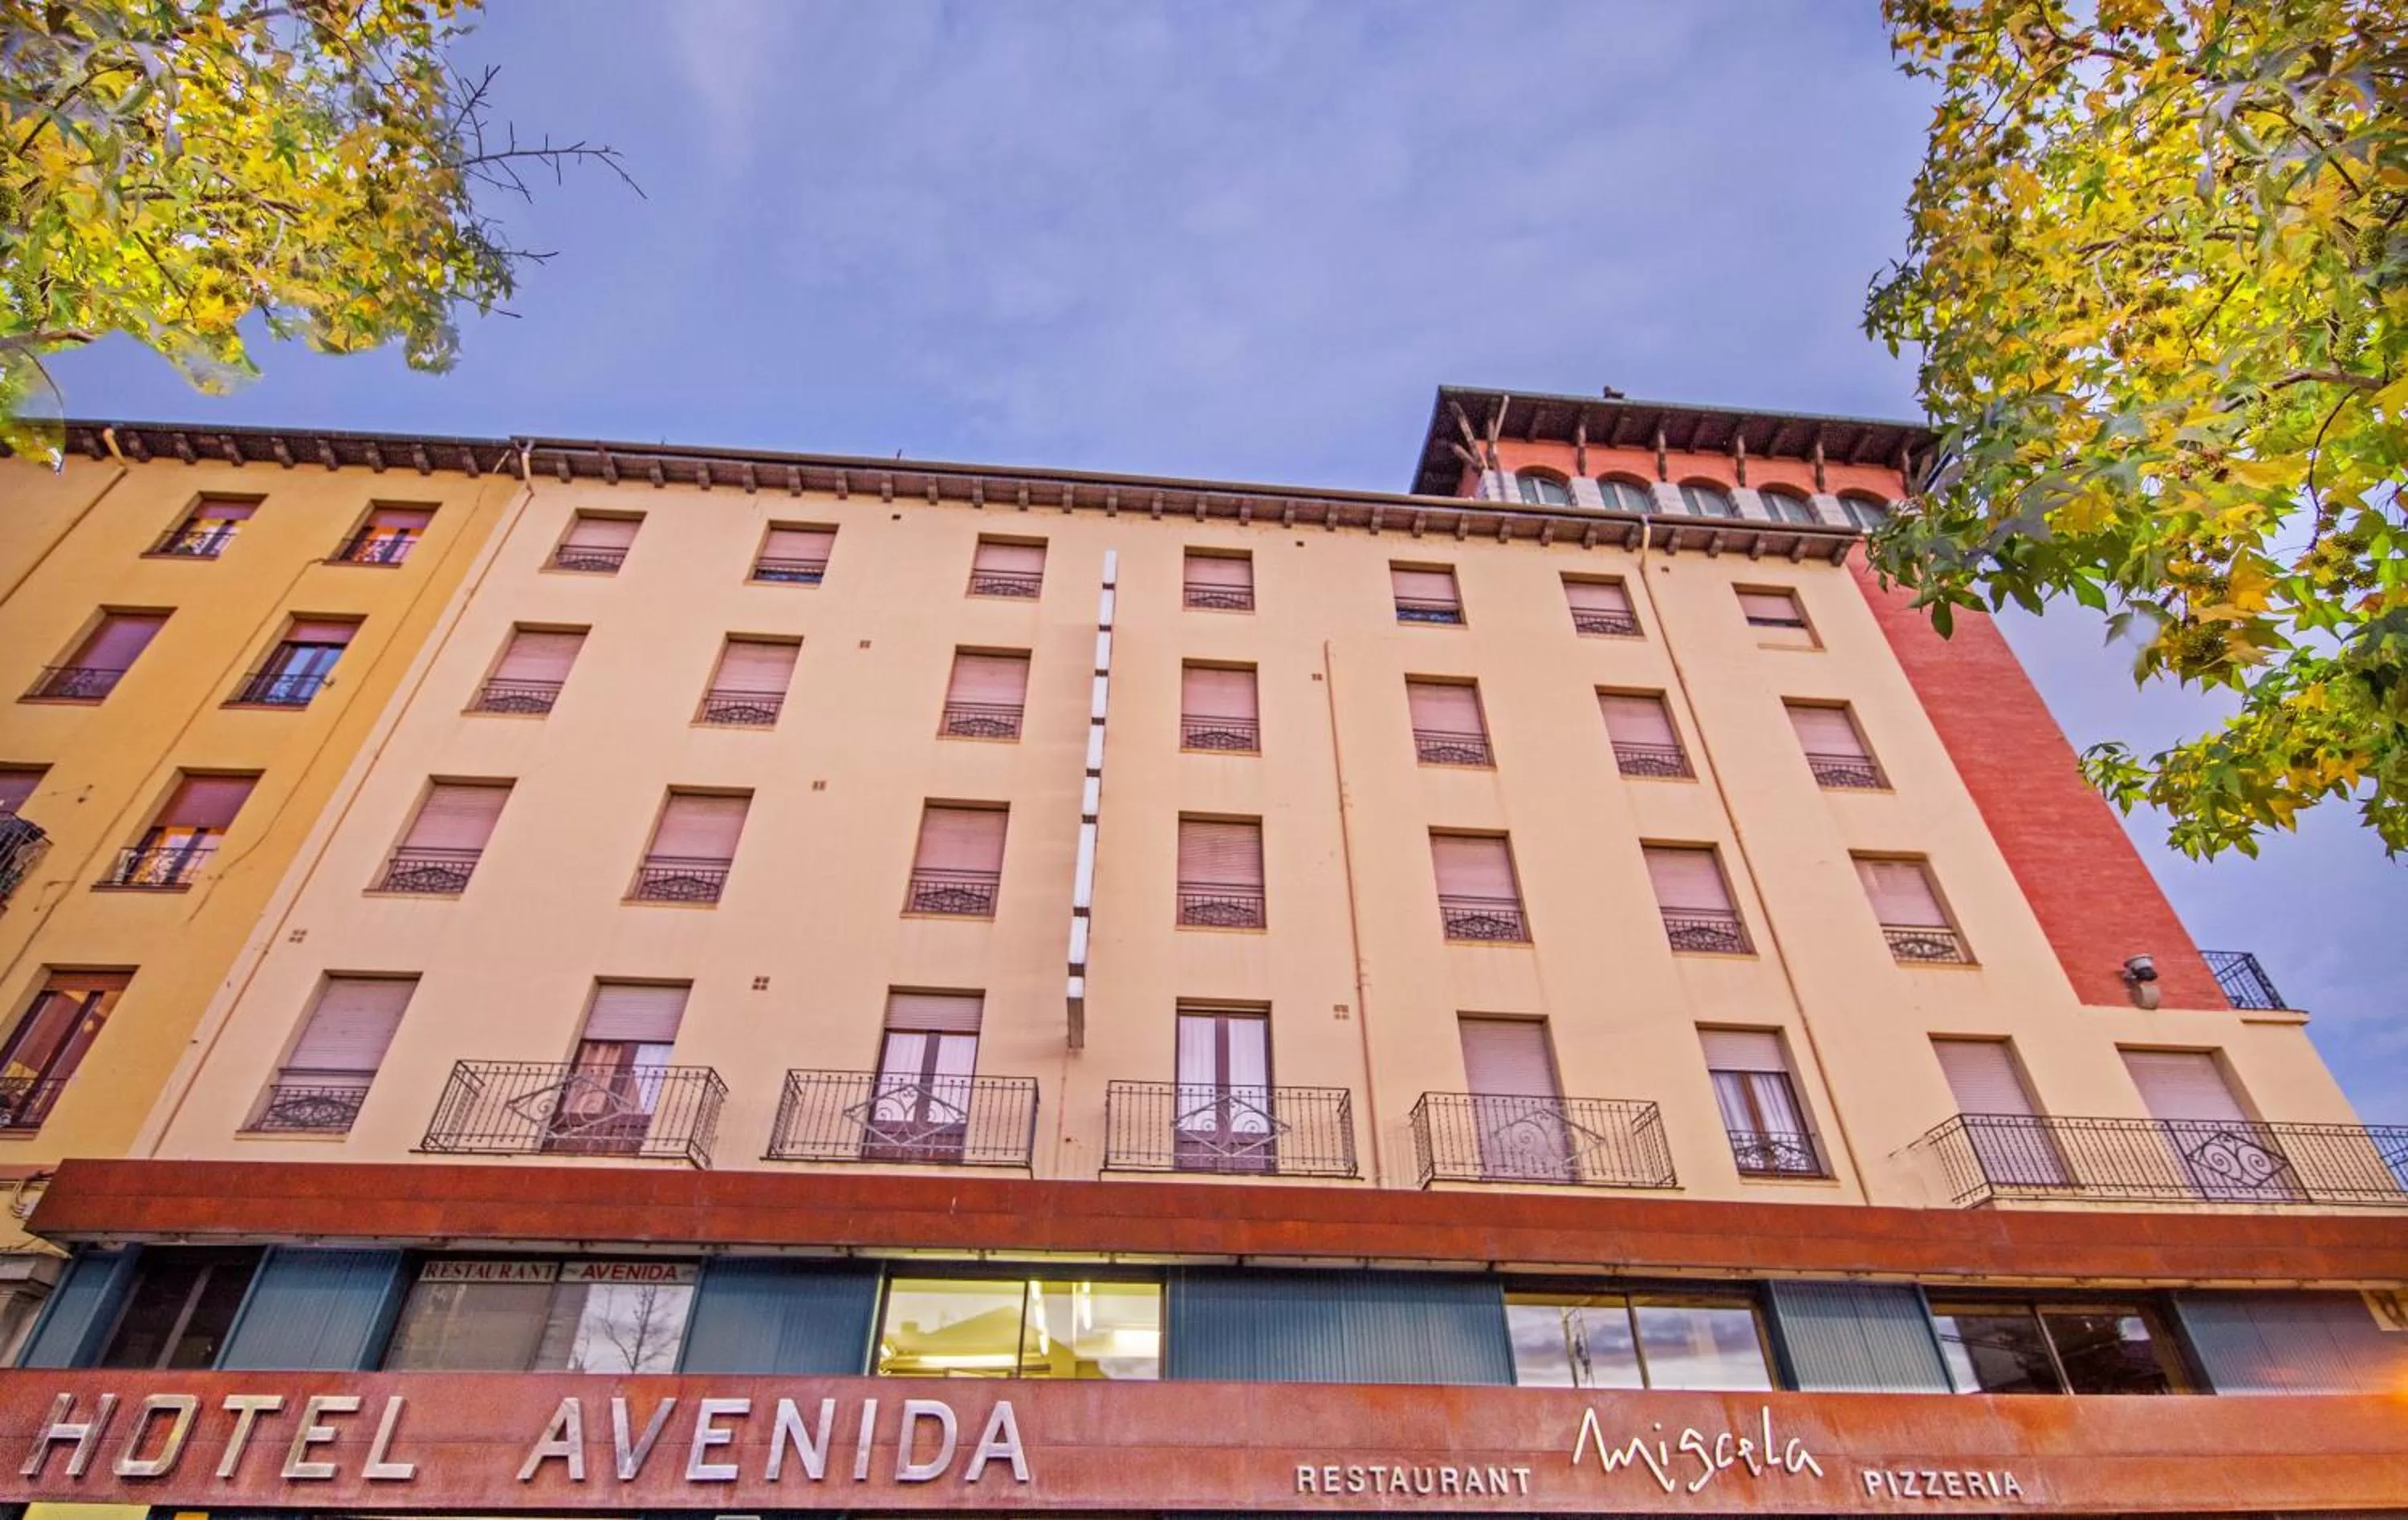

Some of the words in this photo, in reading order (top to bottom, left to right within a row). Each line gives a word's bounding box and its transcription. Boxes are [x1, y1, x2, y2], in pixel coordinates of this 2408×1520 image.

[425, 1263, 555, 1281] RESTAURANT
[580, 1264, 678, 1280] AVENIDA
[19, 1392, 417, 1480] HOTEL
[516, 1396, 1031, 1483] AVENIDA
[1296, 1465, 1532, 1494] RESTAURANT
[1862, 1469, 2023, 1498] PIZZERIA
